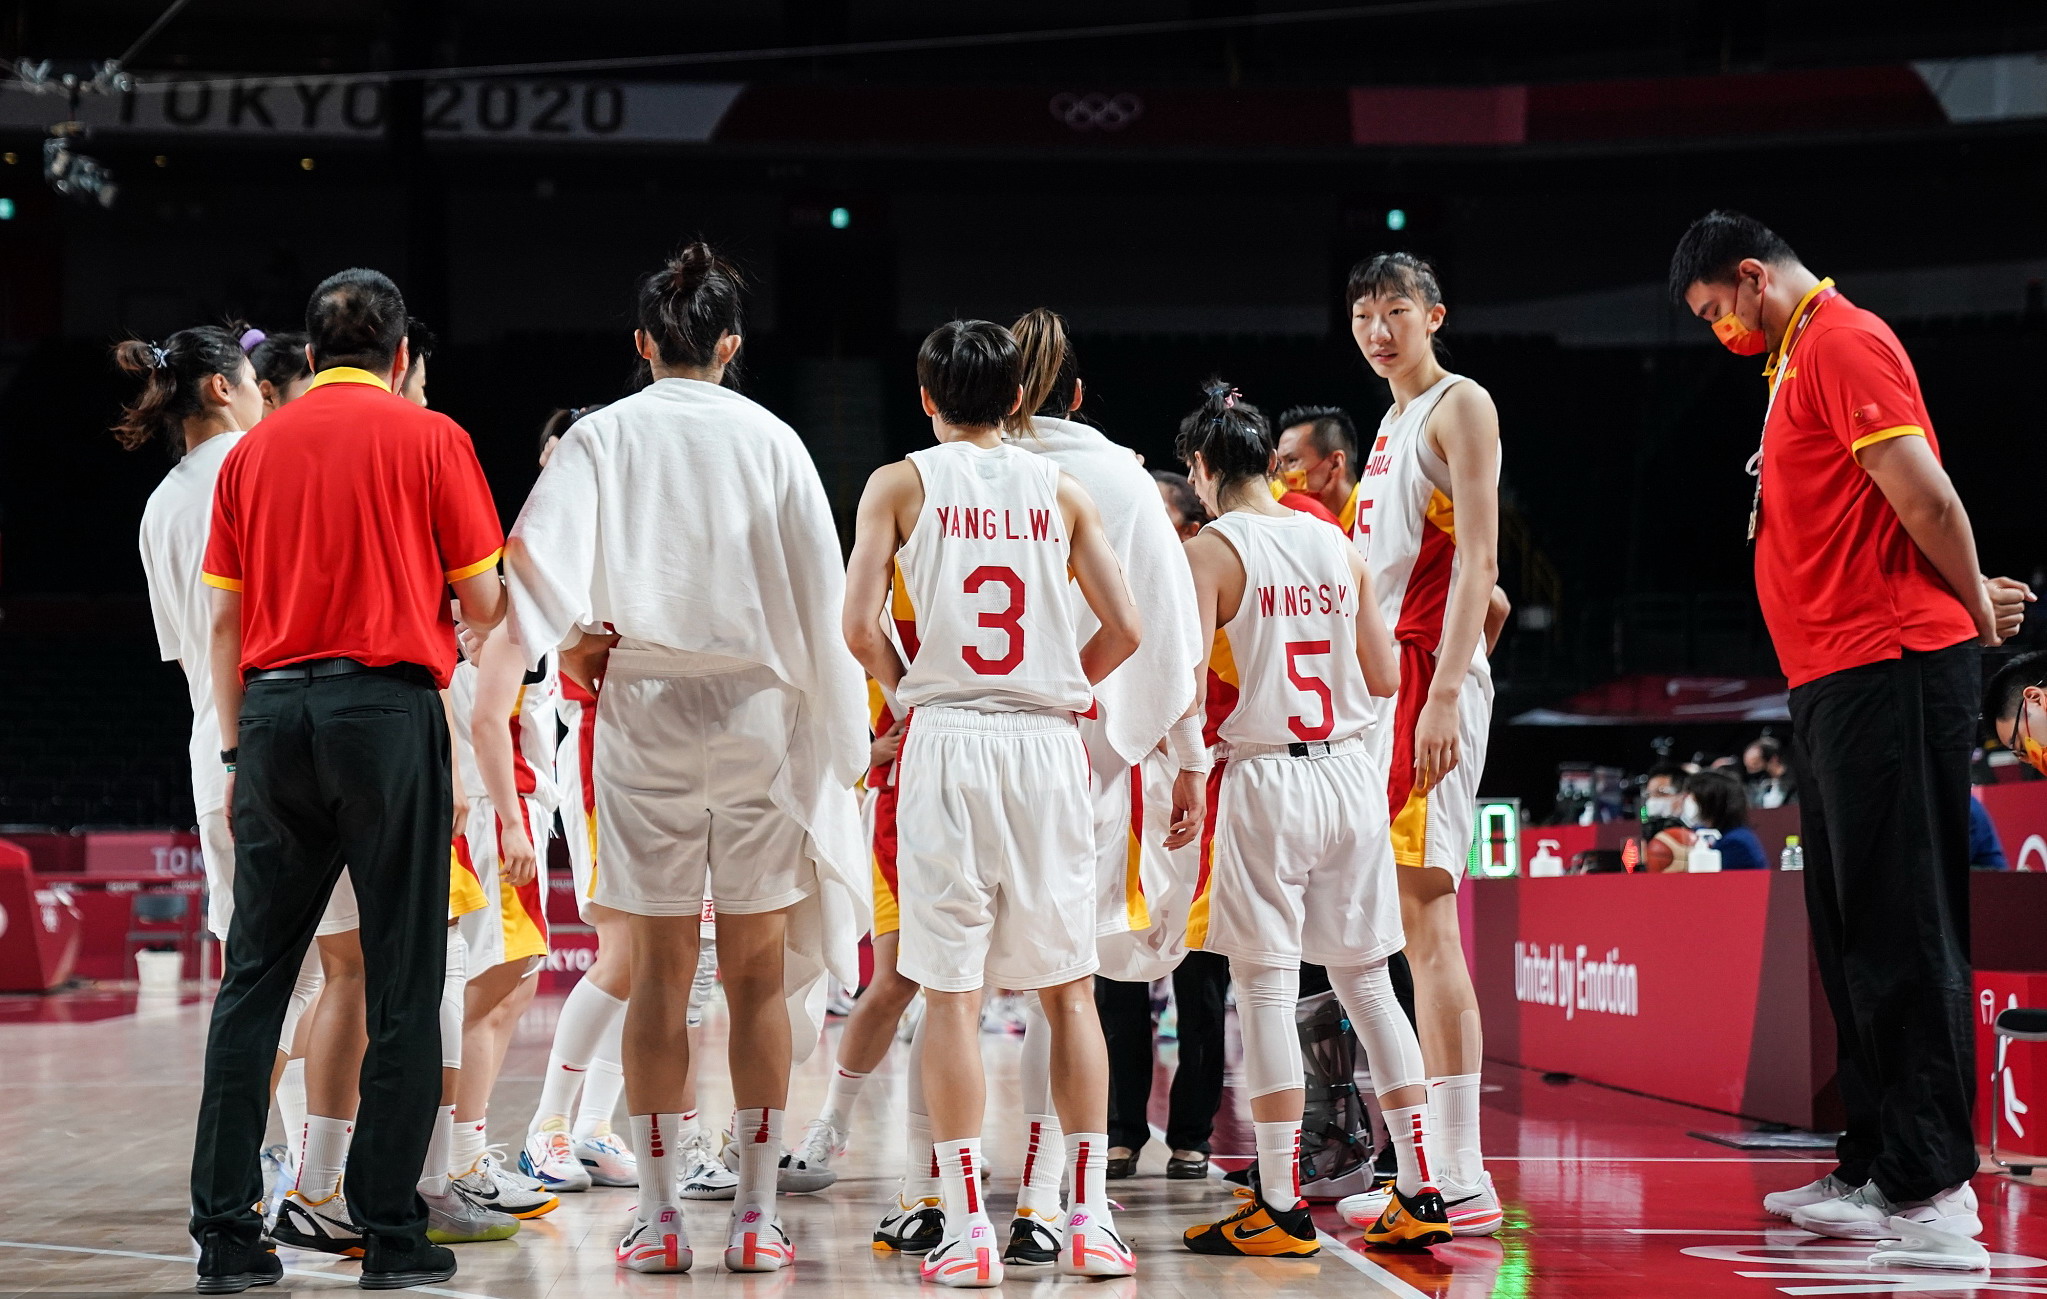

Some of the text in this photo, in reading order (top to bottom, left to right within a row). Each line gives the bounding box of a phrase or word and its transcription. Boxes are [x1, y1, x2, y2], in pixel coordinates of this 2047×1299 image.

[117, 82, 625, 134] TOKYO 2020
[936, 505, 1060, 543] YANG L.W.
[961, 565, 1026, 676] 3
[1285, 640, 1335, 741] 5
[1480, 804, 1517, 877] 0
[1514, 941, 1638, 1021] United by Emotion
